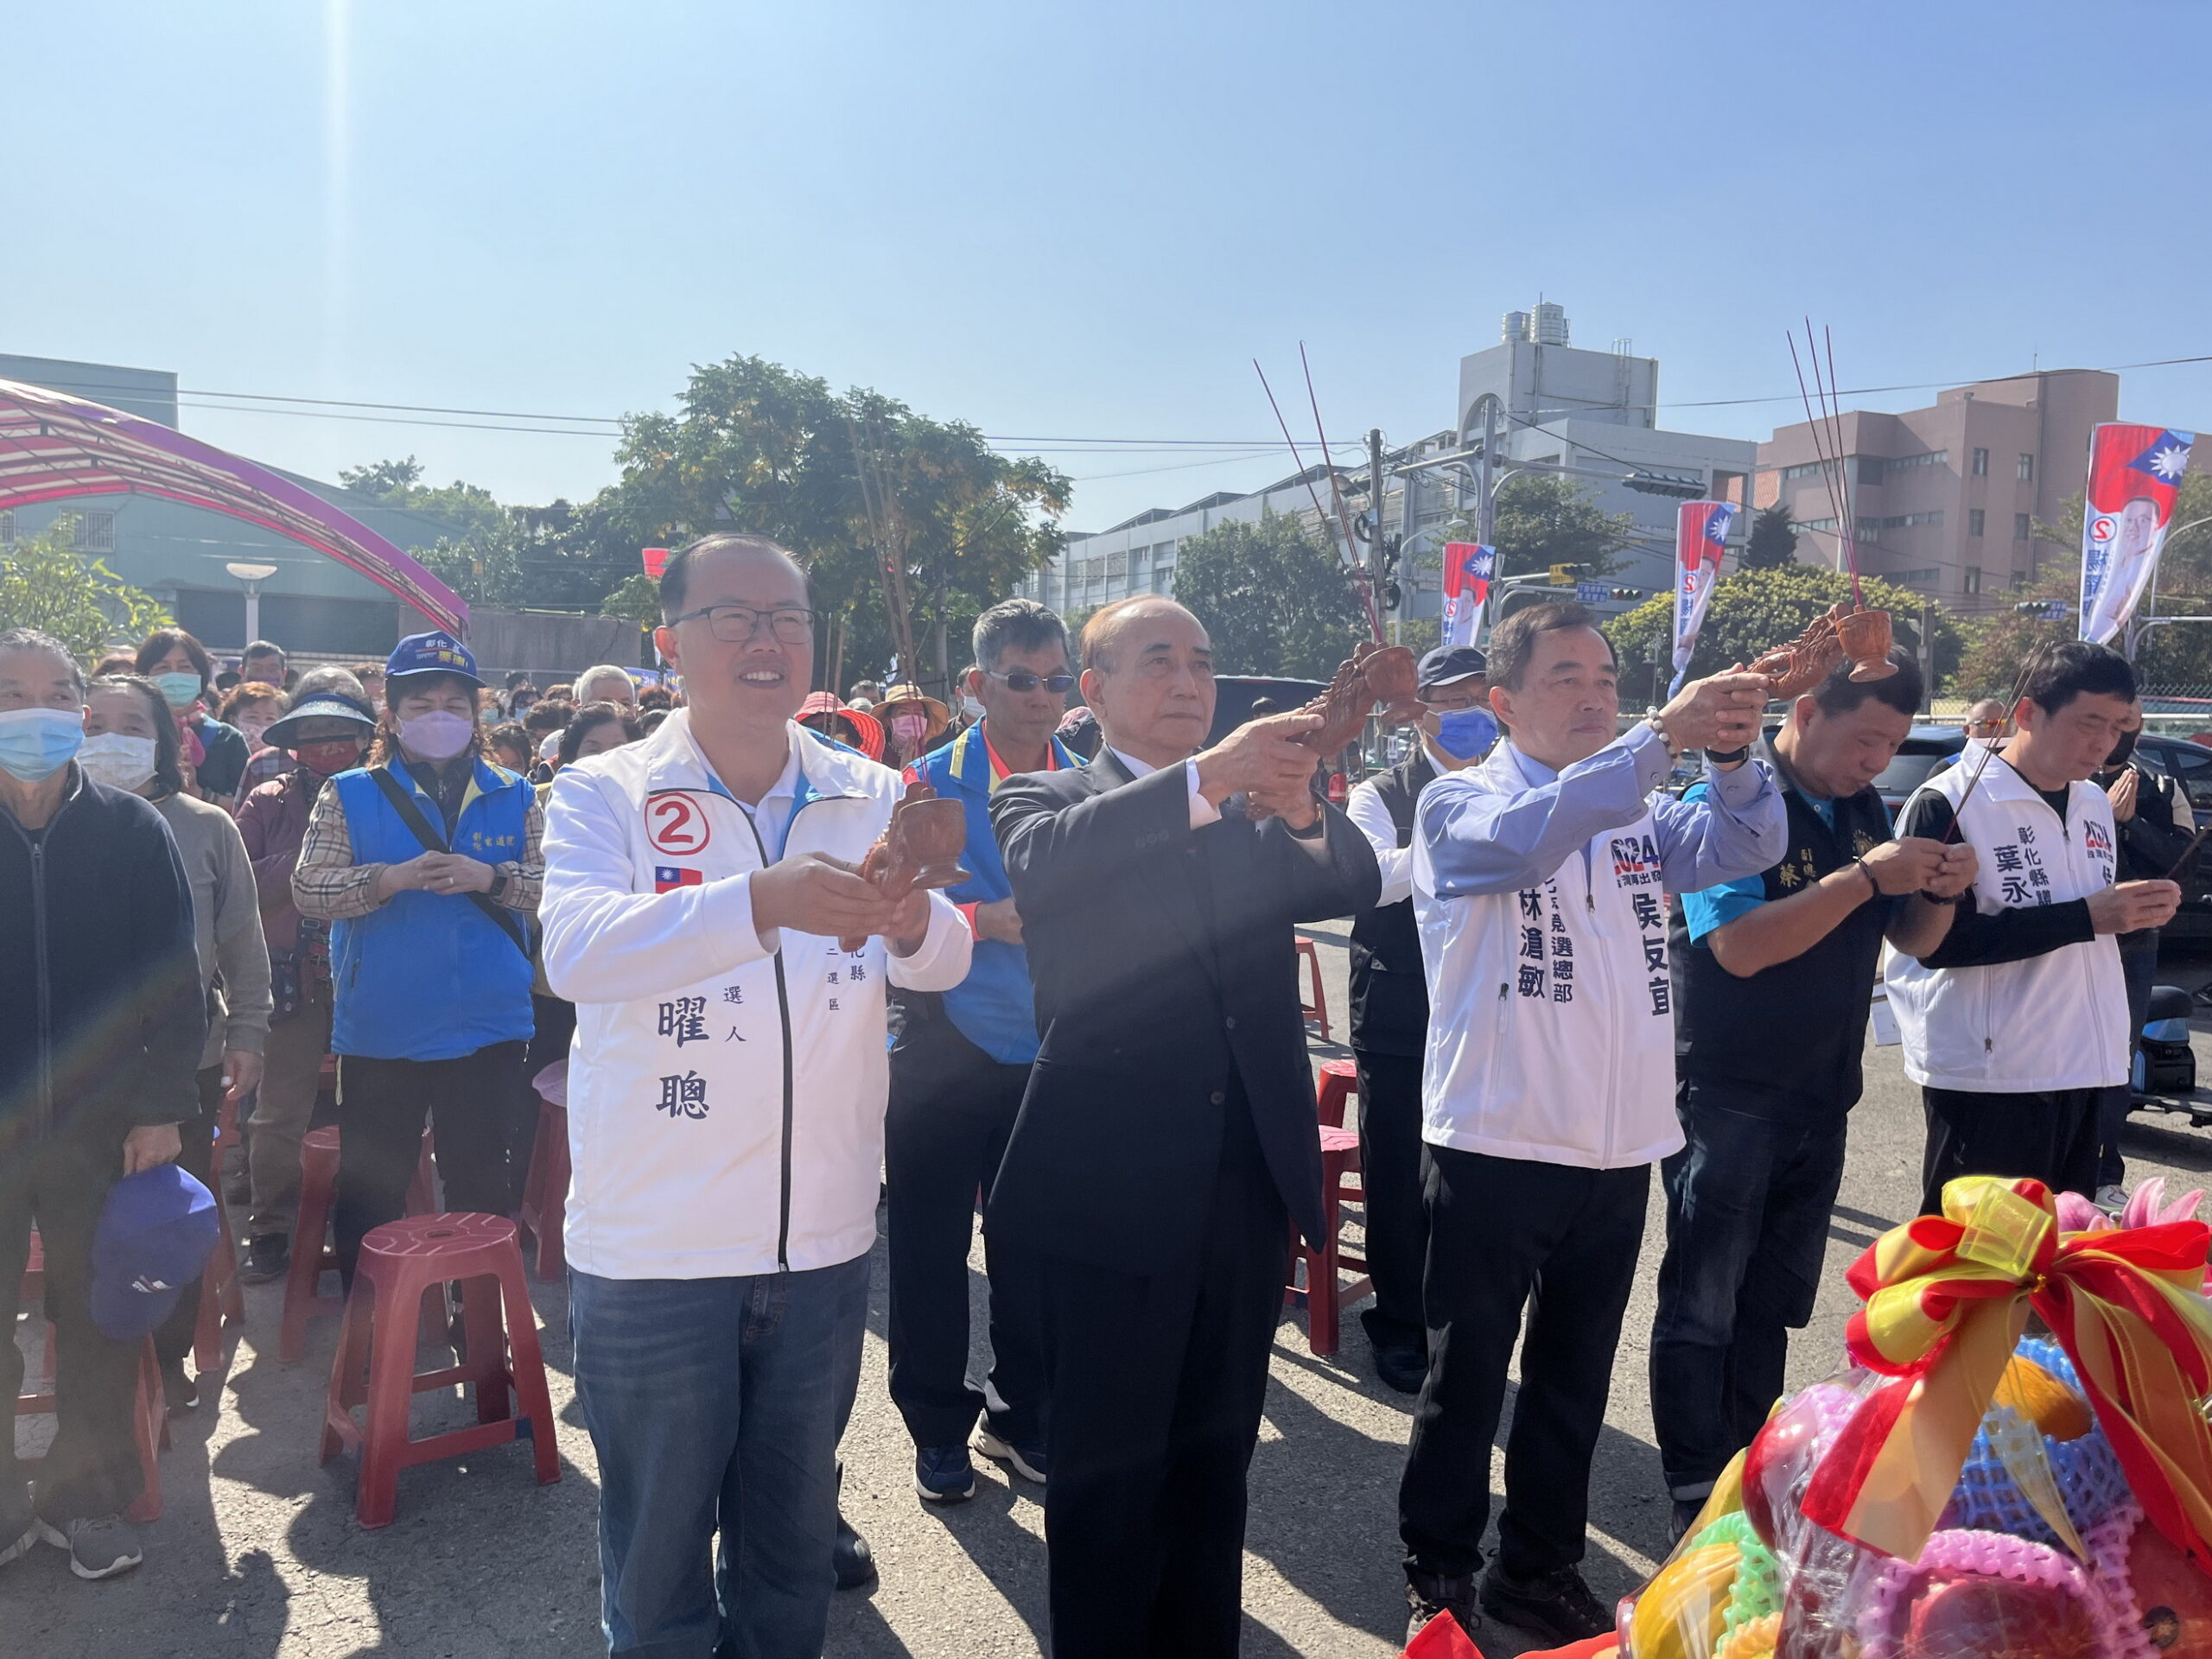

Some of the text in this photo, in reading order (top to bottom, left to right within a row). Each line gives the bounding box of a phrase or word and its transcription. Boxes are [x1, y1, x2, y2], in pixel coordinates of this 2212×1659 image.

[655, 800, 694, 843] 2
[1993, 845, 2033, 904] 葉永
[1518, 888, 1545, 1000] 林滄敏
[1632, 893, 1670, 1016] 侯友宜
[723, 985, 747, 1043] 選人
[655, 995, 710, 1120] 曜聰
